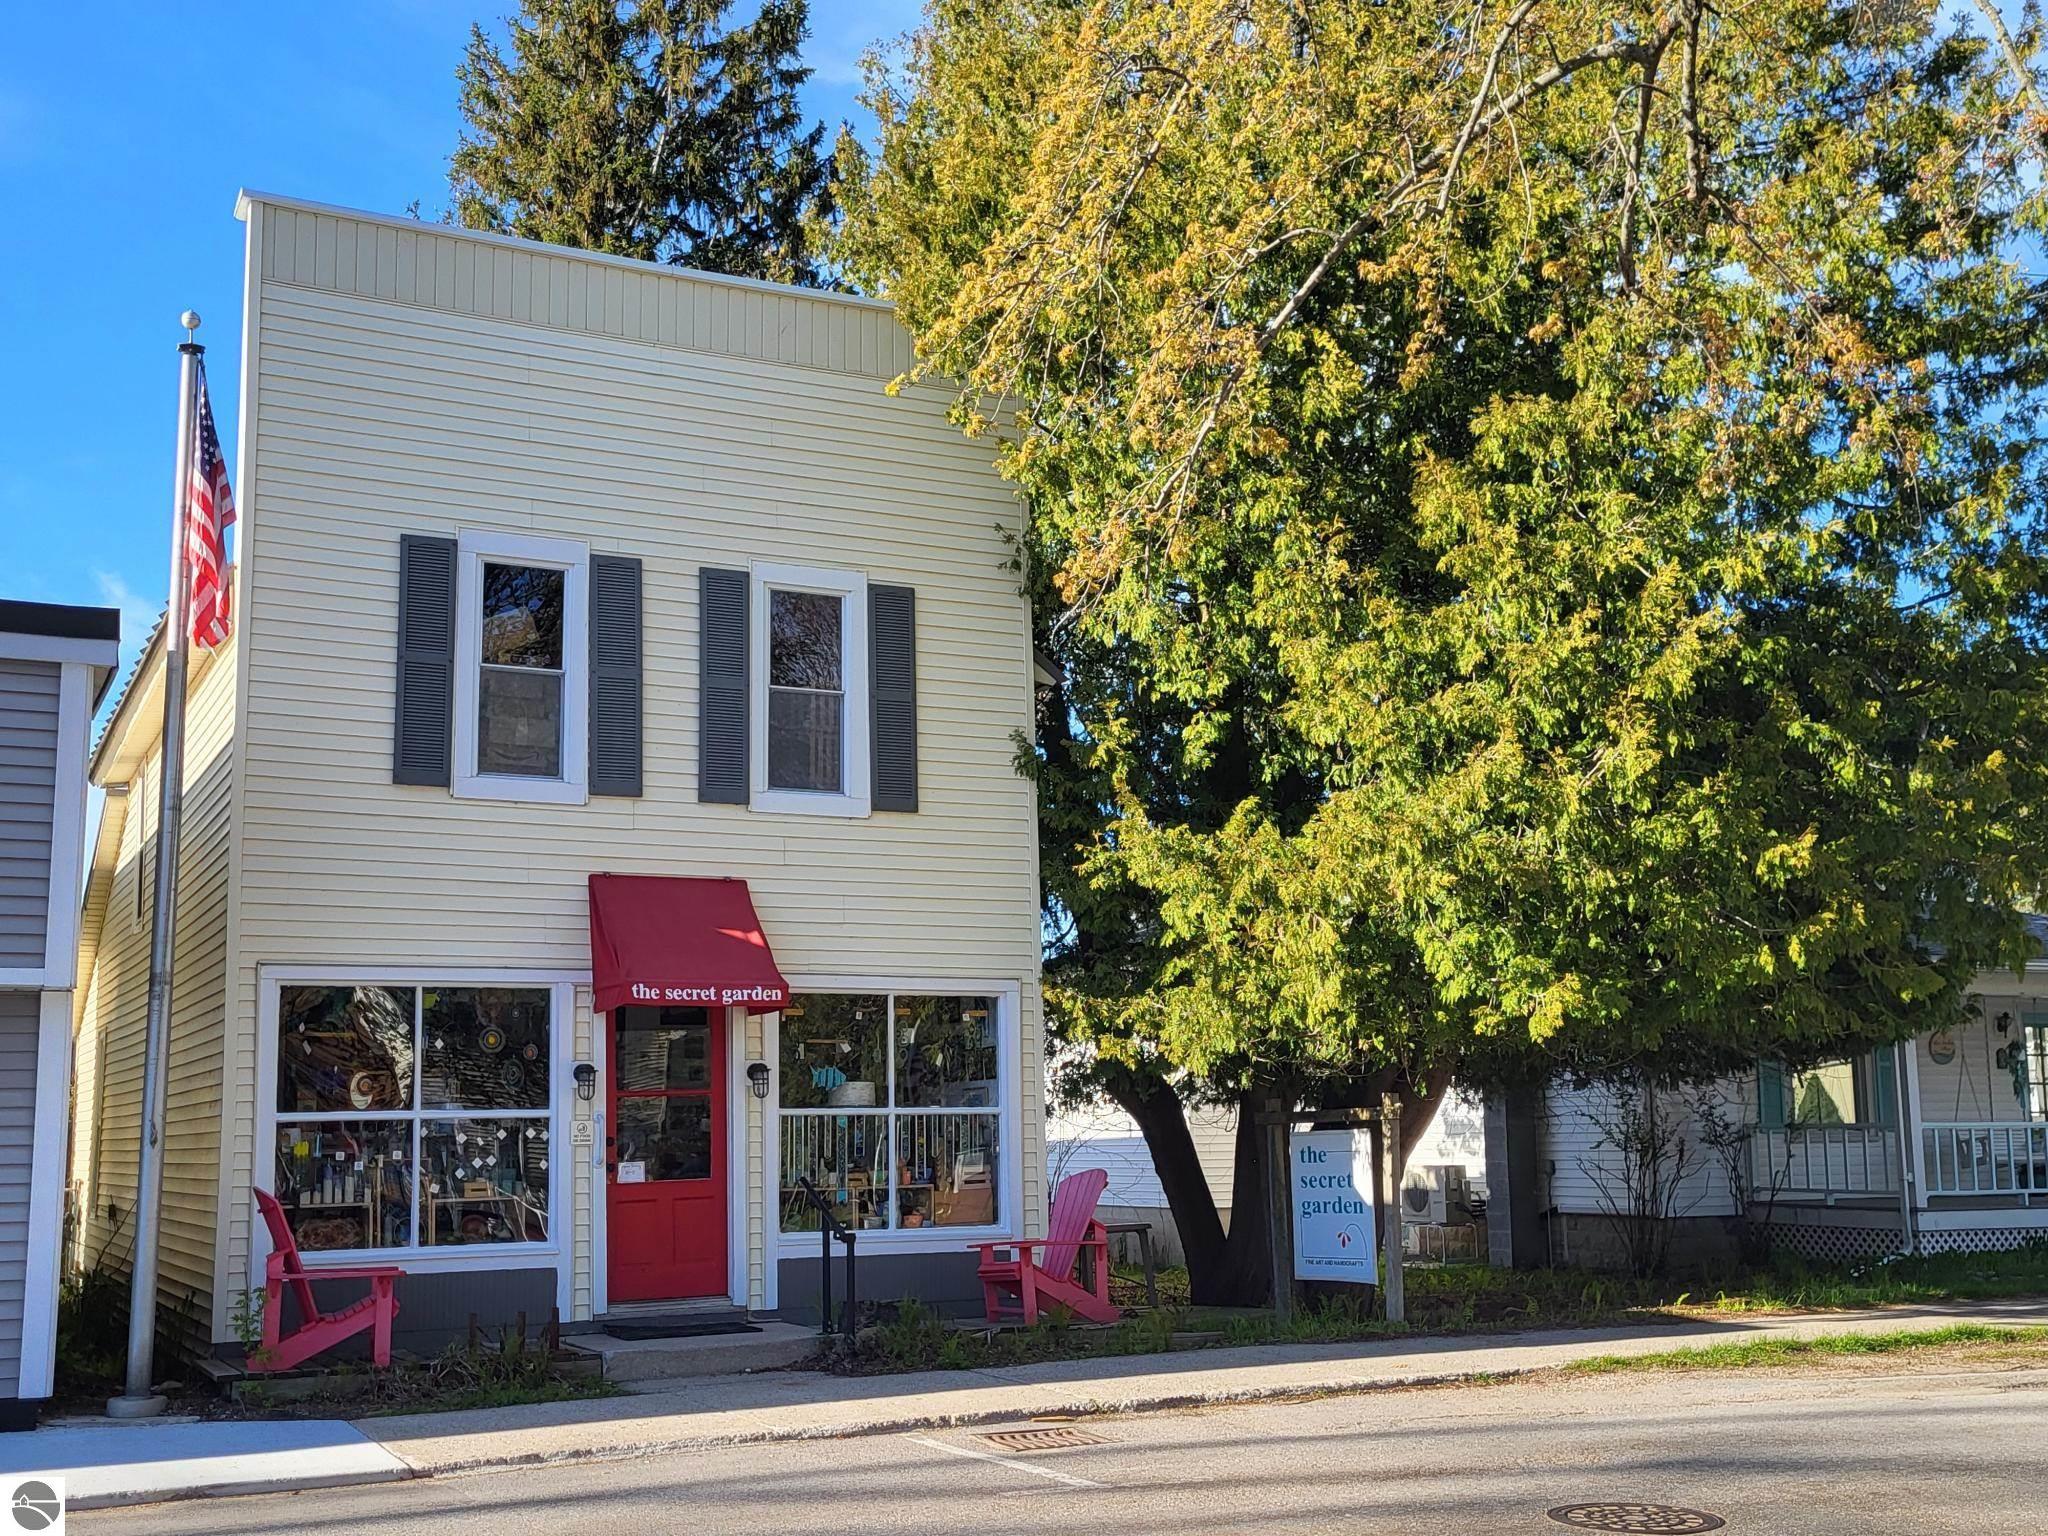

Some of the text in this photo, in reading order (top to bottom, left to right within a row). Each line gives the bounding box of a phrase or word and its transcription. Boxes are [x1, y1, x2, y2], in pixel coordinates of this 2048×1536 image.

[632, 983, 782, 1005] the secret garden
[1300, 1146, 1327, 1163] the
[1300, 1172, 1353, 1189] secret
[1301, 1196, 1364, 1219] garden
